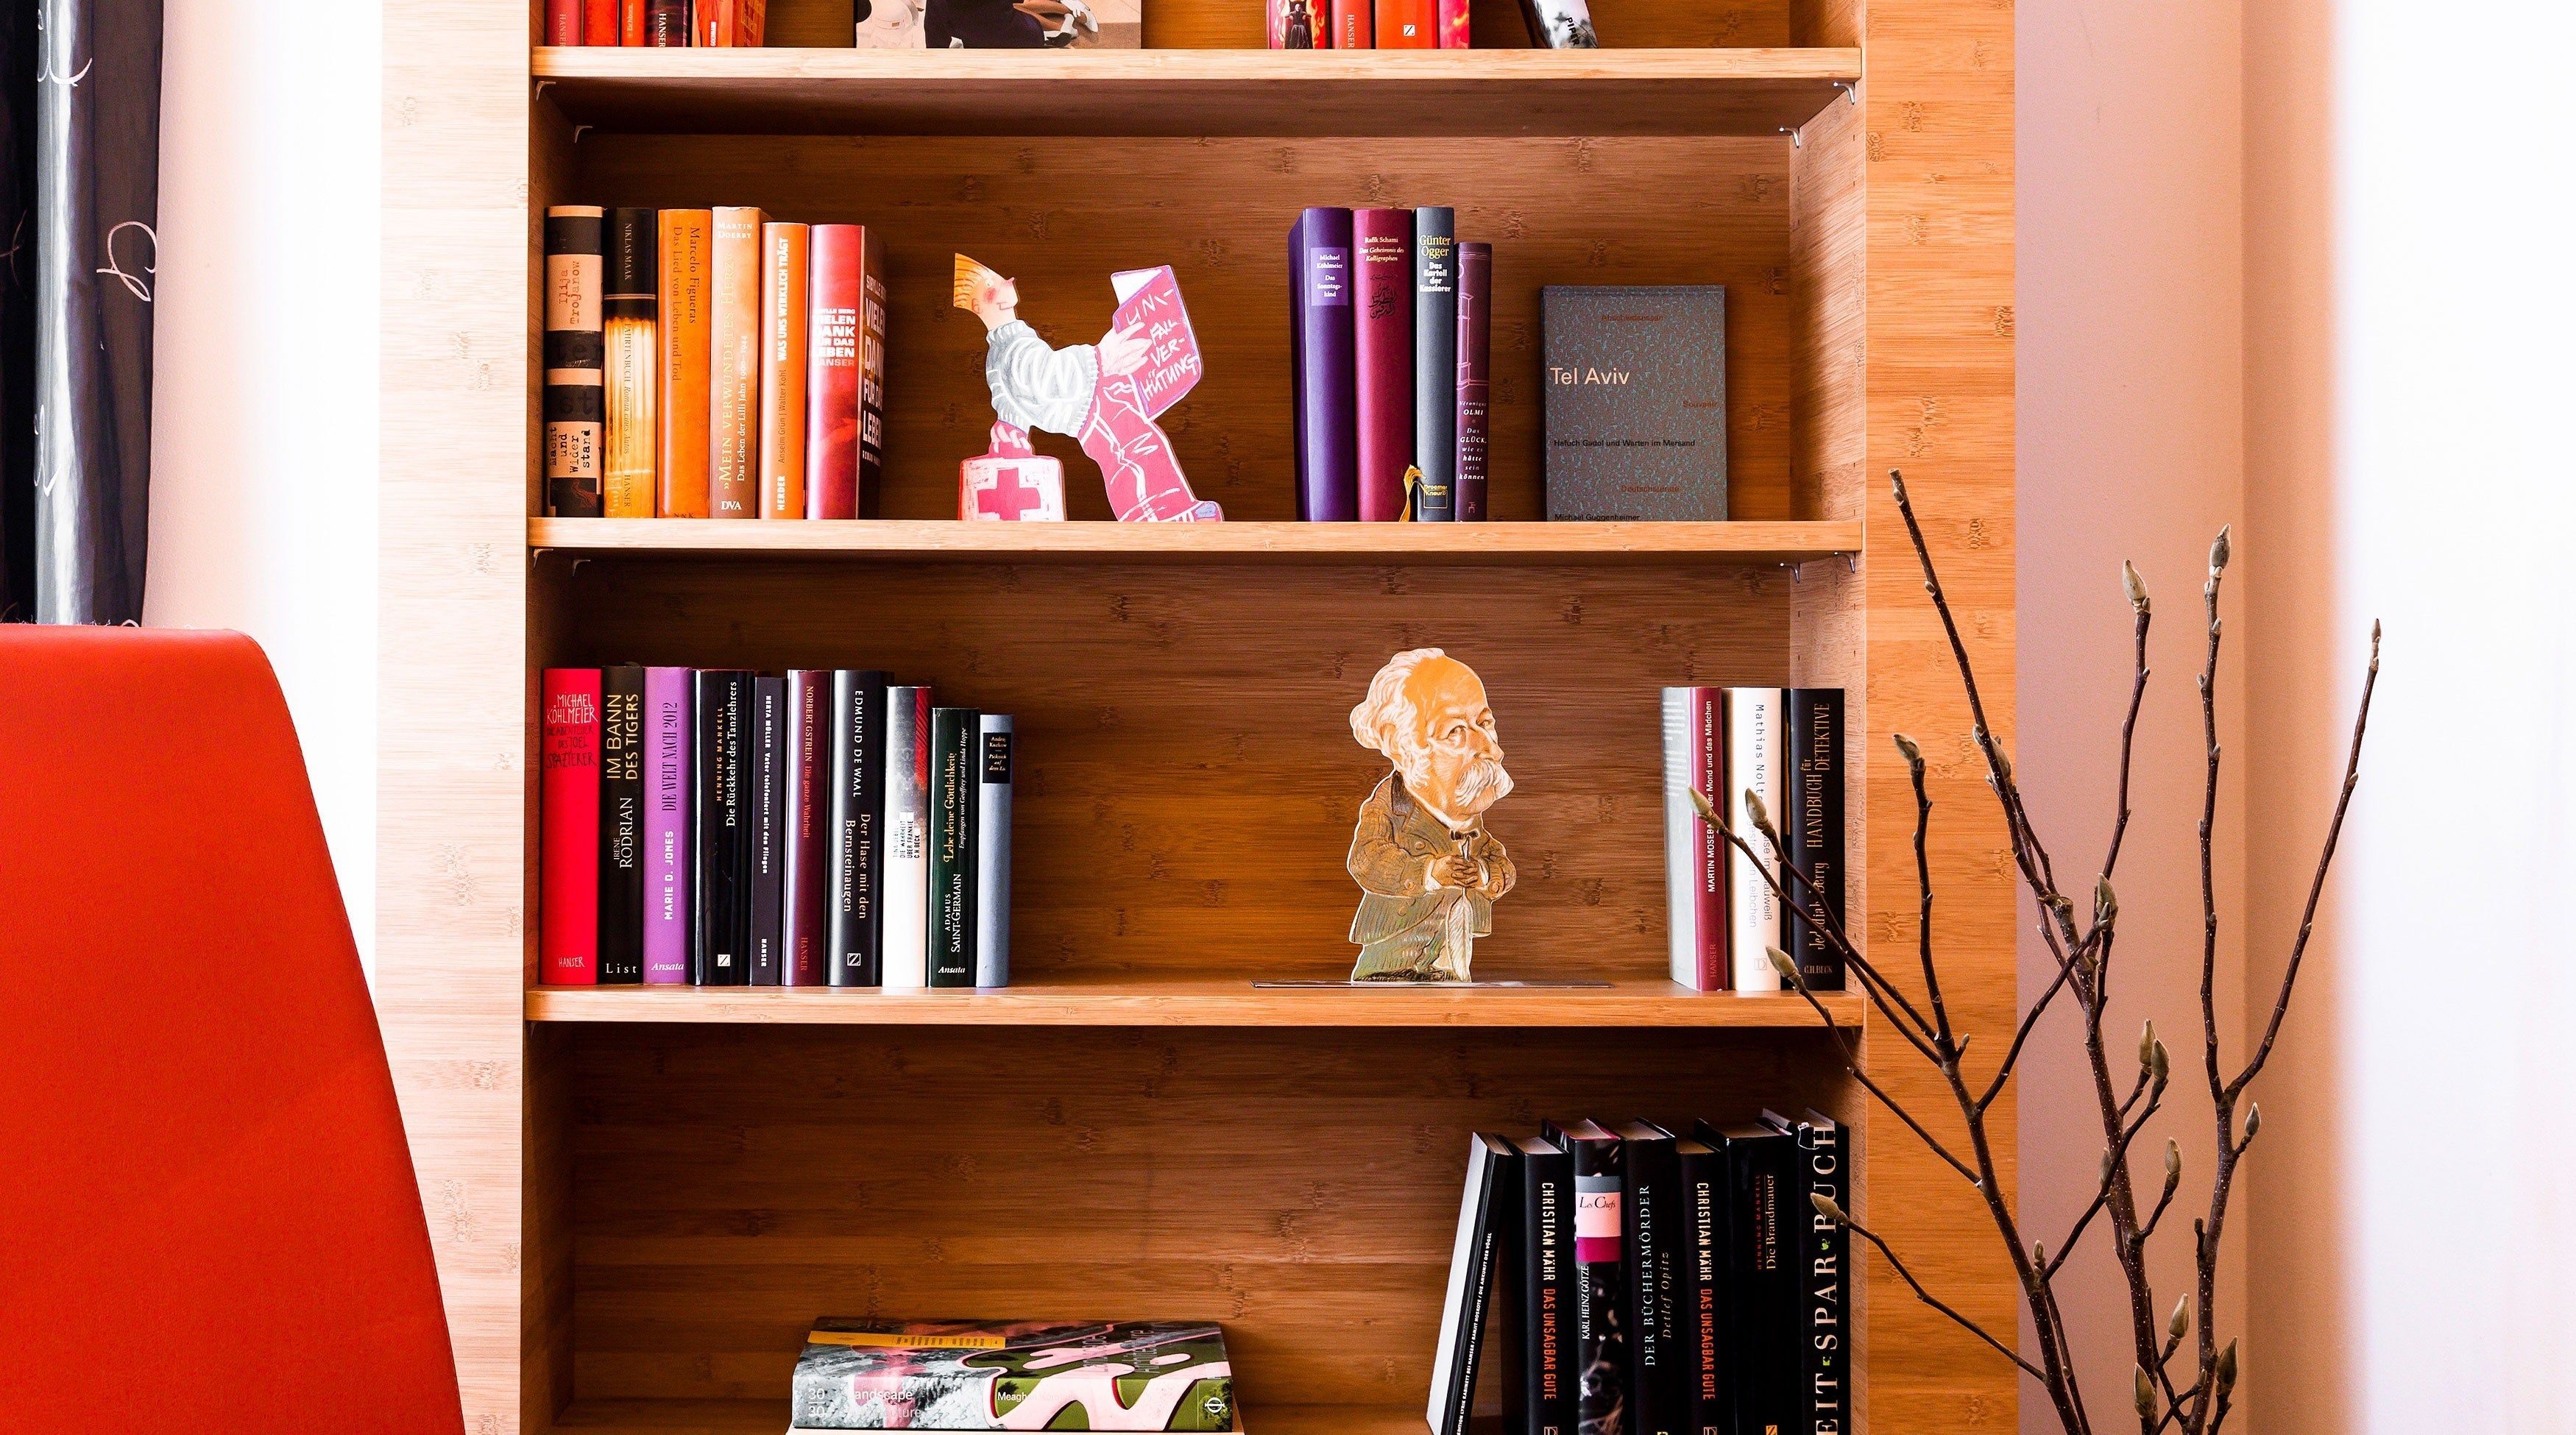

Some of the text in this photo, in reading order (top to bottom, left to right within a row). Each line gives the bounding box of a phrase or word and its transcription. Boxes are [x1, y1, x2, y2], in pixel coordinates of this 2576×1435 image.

[658, 13, 667, 47] HANSER
[1347, 14, 1356, 49] HANSER
[1565, 17, 1580, 46] PIPER
[624, 223, 633, 281] NIKLAS MAAK
[1419, 235, 1451, 246] Günter
[1421, 247, 1449, 259] Ogger
[559, 269, 570, 305] Ilija
[567, 260, 581, 325] Trojanow
[686, 227, 701, 325] Marcelo Figueras
[1423, 269, 1447, 277] Kartell
[1429, 277, 1443, 285] der
[671, 226, 684, 382] Das Lied von Leben und Tod
[776, 236, 789, 362] WAS UNS WIRKLICH TRÄGT
[623, 322, 632, 412] FAHRTENBUCH Roman
[1550, 367, 1630, 385] Tel Aviv
[737, 383, 748, 482] Das Leben der Lilli Jahn
[777, 369, 788, 464] Anselm Grün Walter Kohl
[549, 426, 557, 467] Macht
[559, 433, 567, 458] und
[569, 435, 579, 474] Wider
[581, 429, 591, 469] stand
[623, 474, 631, 508] HANSER
[721, 500, 742, 511] DVA
[776, 475, 786, 511] HERDER
[1585, 514, 1641, 522] Guggenheimer
[606, 694, 623, 779] IM BANN
[626, 693, 639, 780] DES TIGERS
[726, 681, 737, 827] Die Rückkehr des Tanzlehrers
[852, 690, 863, 798] EDMUND DE WAAL
[960, 727, 968, 748] Hoppe
[1755, 704, 1765, 759] Mathias
[1814, 703, 1830, 771] DETEKTIVE
[662, 701, 678, 812] DIE WELT NACH 2012
[802, 685, 814, 839] NORBERT GSTREIN ganze Wahrheit
[1800, 758, 1812, 771] für
[959, 779, 968, 804] Geoffrey
[1704, 701, 1716, 893] MARTIN Mond und das Mädchen
[1806, 774, 1824, 848] HANDBUCH
[613, 837, 621, 861] IRENE
[619, 797, 634, 869] RODRIAN
[943, 811, 955, 862] Lebe deine
[958, 816, 967, 849] Empfangen
[664, 830, 675, 921] MARIE JONES
[841, 819, 856, 913] Bernsteinaugen
[858, 813, 871, 920] Der Hase mit den
[950, 873, 962, 954] SAINT-GERMAIN
[1748, 879, 1759, 929] Leibchen
[558, 956, 585, 968] HANSER
[606, 963, 637, 974] List
[651, 962, 684, 971] Ansata
[760, 938, 768, 968] HANSER
[800, 936, 809, 972] HANSER
[937, 966, 966, 974] Ansata
[1709, 943, 1718, 978] HANSER
[1594, 1196, 1616, 1211] Chefs
[1765, 1174, 1776, 1270] Die Brandmauer
[1541, 1182, 1557, 1400] CHRISTIAN MÄHR DAS UNSAGBAR GUTE
[1638, 1185, 1656, 1367] DER BÜCHERMÖRDER
[1660, 1252, 1673, 1339] Detlef Opitz
[1696, 1182, 1716, 1401] CHRISTIAN MÄHR DAS UNSAGBAR GUTE
[1580, 1293, 1590, 1340] KARL HEINZ
[1814, 1253, 1839, 1350] SPAR
[1462, 1261, 1488, 1400] KABINETT ANKUNFT
[808, 1388, 825, 1400] 30
